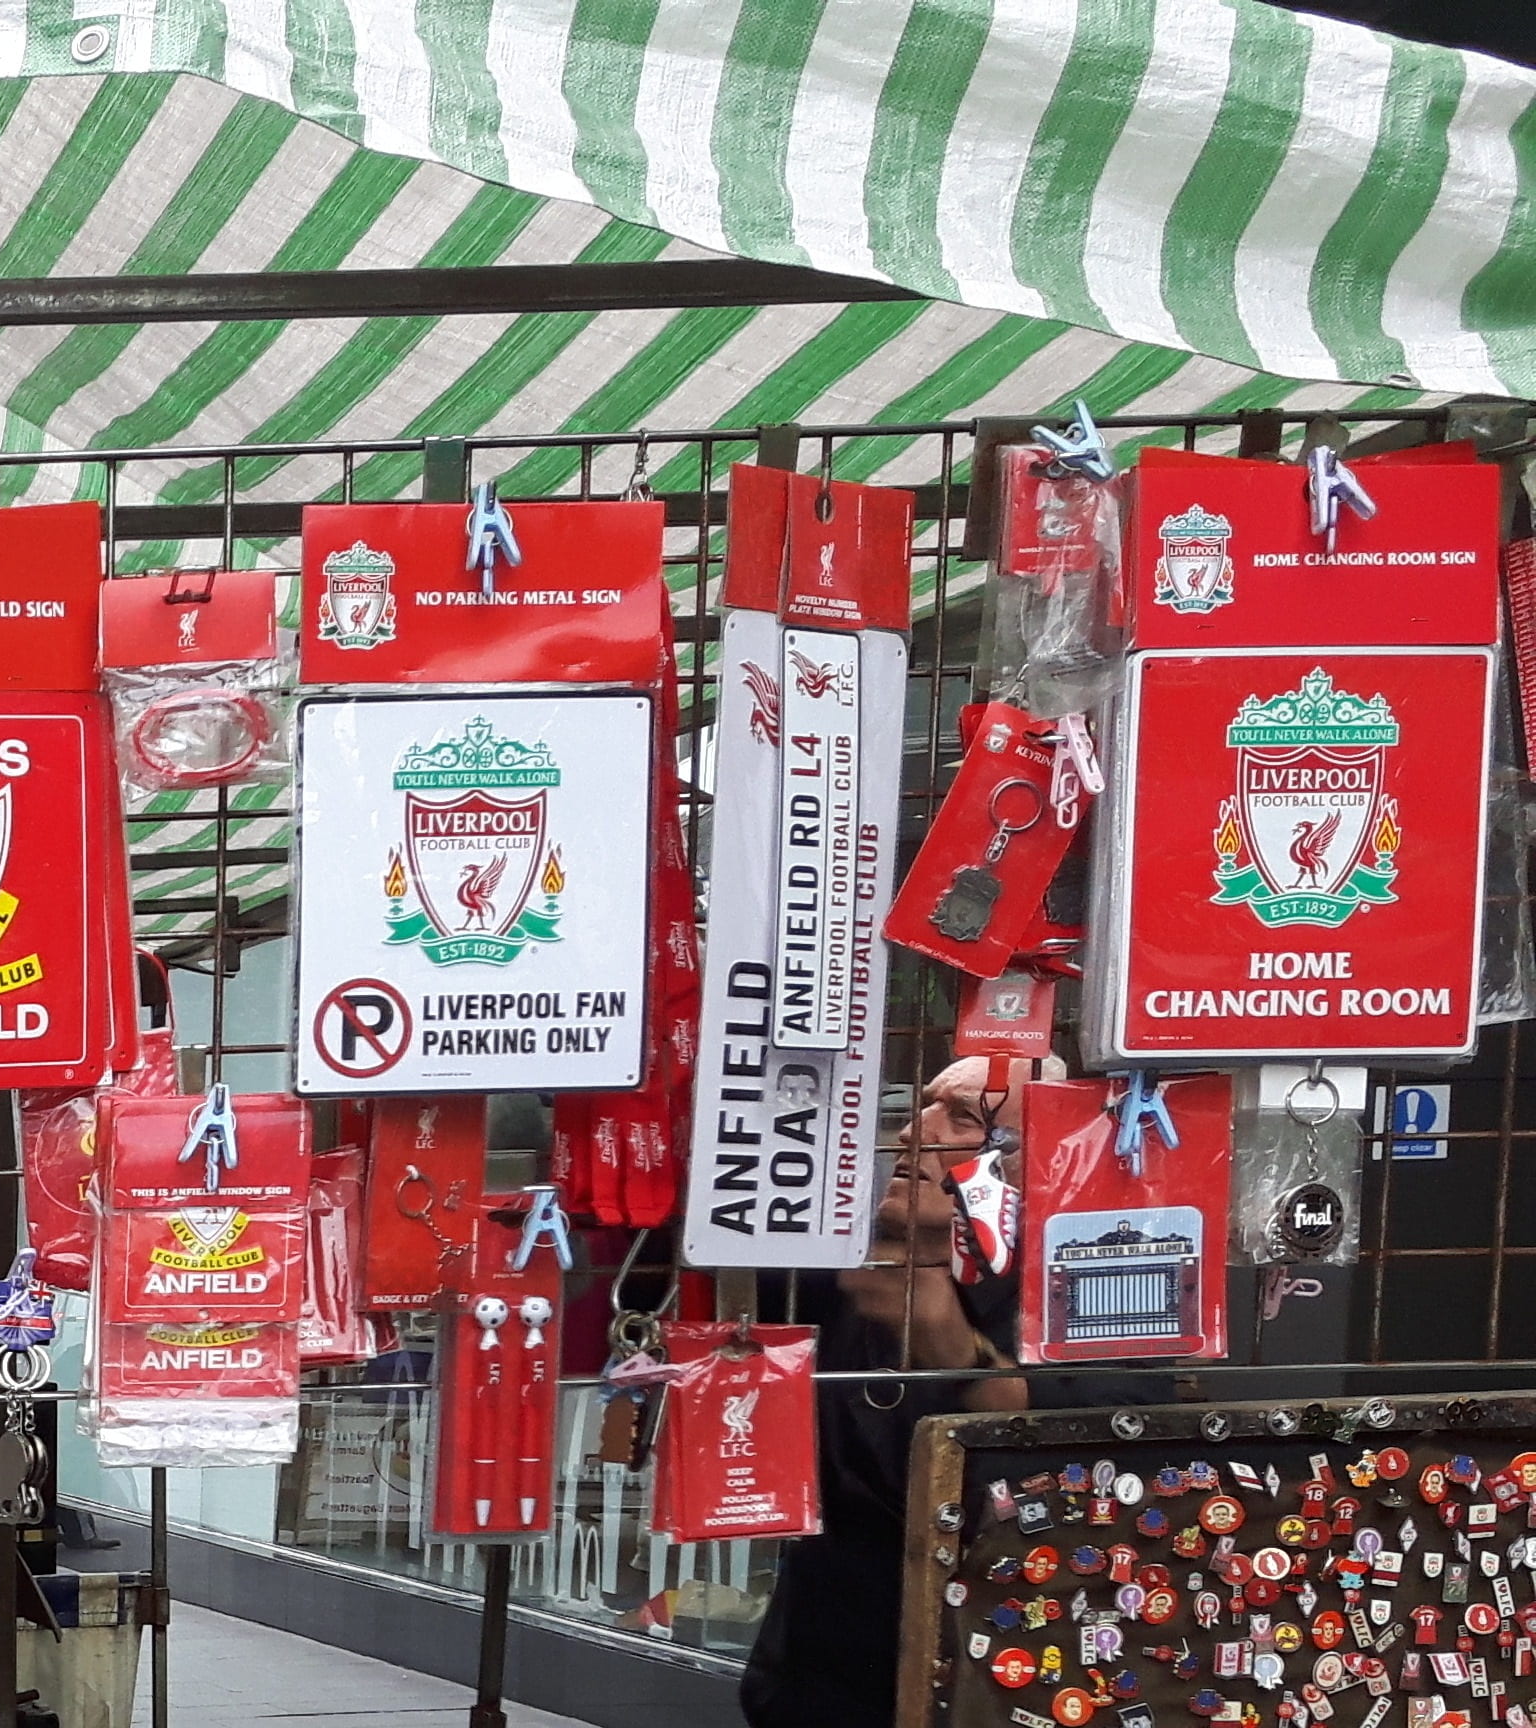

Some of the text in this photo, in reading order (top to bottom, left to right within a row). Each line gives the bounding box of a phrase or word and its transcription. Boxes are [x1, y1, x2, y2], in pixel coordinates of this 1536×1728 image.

[1254, 552, 1476, 566] HOME CHANGING ROOM SIGN
[417, 589, 620, 606] NO PARKING METAL SIGN
[26, 602, 64, 617] SIGN
[1233, 727, 1393, 742] YOU'LL NEVER WALK ALONE
[1251, 770, 1371, 789] LIVERPOOL
[783, 733, 821, 1033] ANFIELD RD L4
[1249, 952, 1352, 980] HOME
[424, 991, 625, 1022] LIVERPOOL FAN
[1146, 988, 1451, 1018] CHANGING ROOM
[422, 1027, 611, 1055] PARKING ONLY
[710, 962, 771, 1234] ANFIELD
[263, 1187, 291, 1195] SIGN
[145, 1274, 268, 1294] ANFIELD
